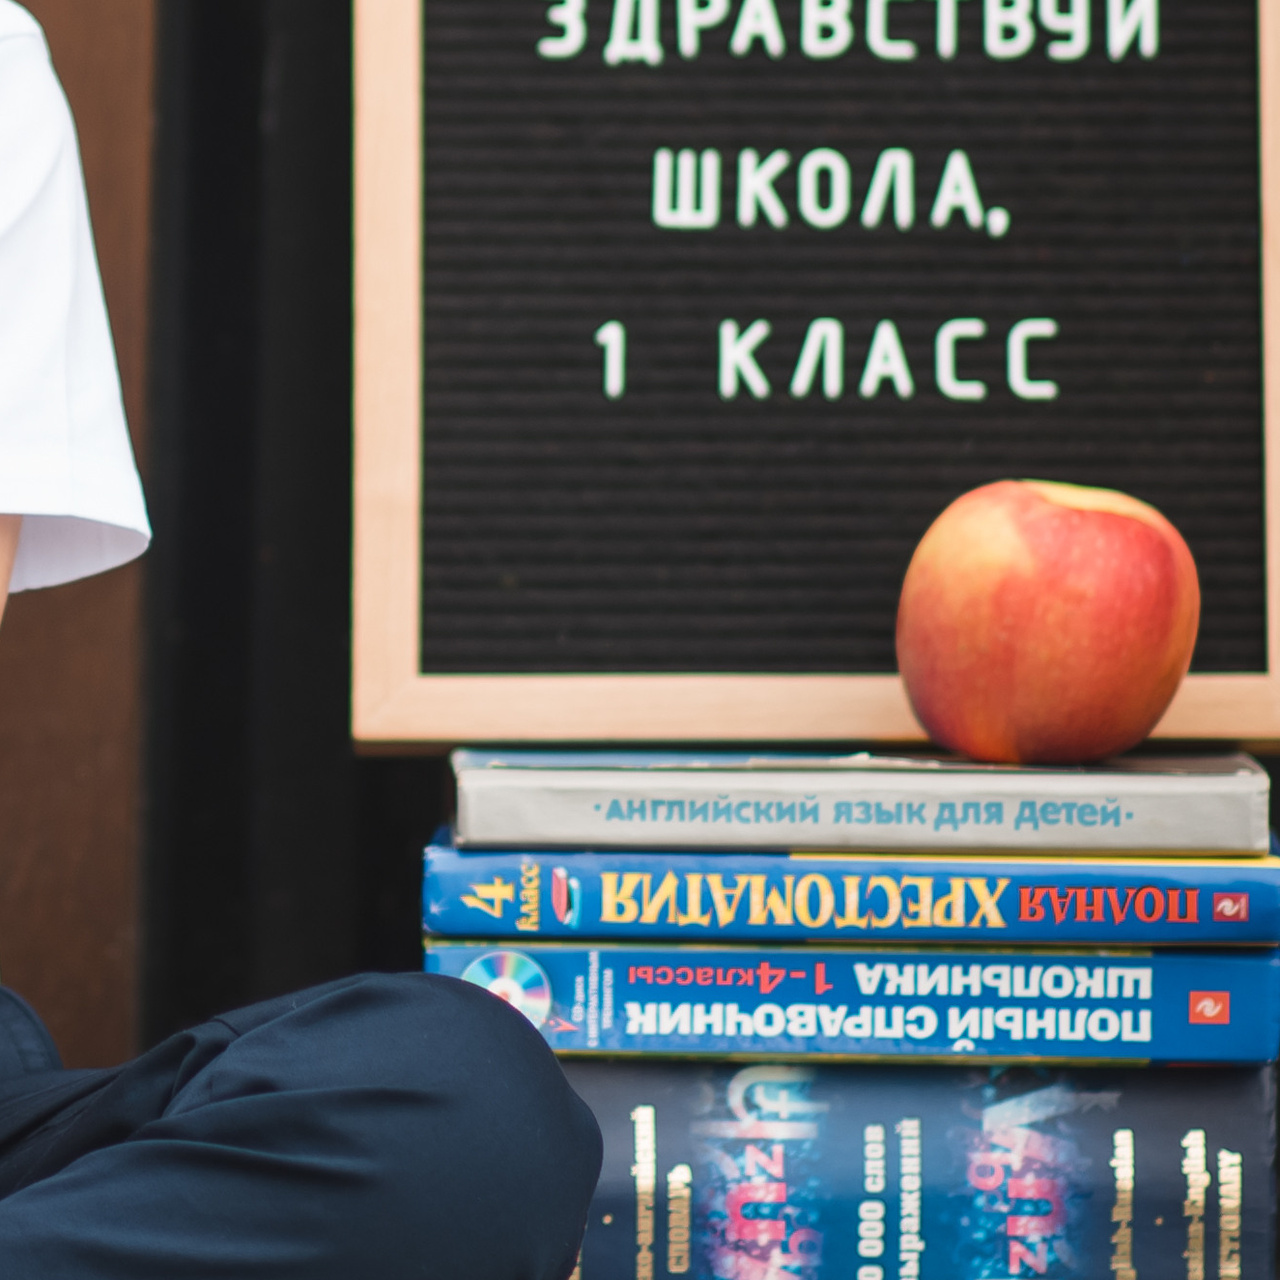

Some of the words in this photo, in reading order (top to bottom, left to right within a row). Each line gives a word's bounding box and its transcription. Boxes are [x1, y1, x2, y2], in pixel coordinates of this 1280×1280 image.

[654, 150, 1008, 235] ШКОЛА,
[597, 323, 623, 397] 1
[721, 320, 1056, 399] КЛАСС
[462, 878, 513, 916] 4
[602, 872, 1009, 928] ХРЕСТОМАТИЯ
[1017, 884, 1200, 925] ПОЛНАЯ
[855, 965, 1151, 998] ШКОЛЬНИКА
[626, 1003, 936, 1038] СПРАВОЧНИК
[949, 1008, 1150, 1051] ПОЛНЫЙ
[895, 1118, 925, 1280] ыражений
[1217, 1148, 1242, 1280] ICTIONARY
